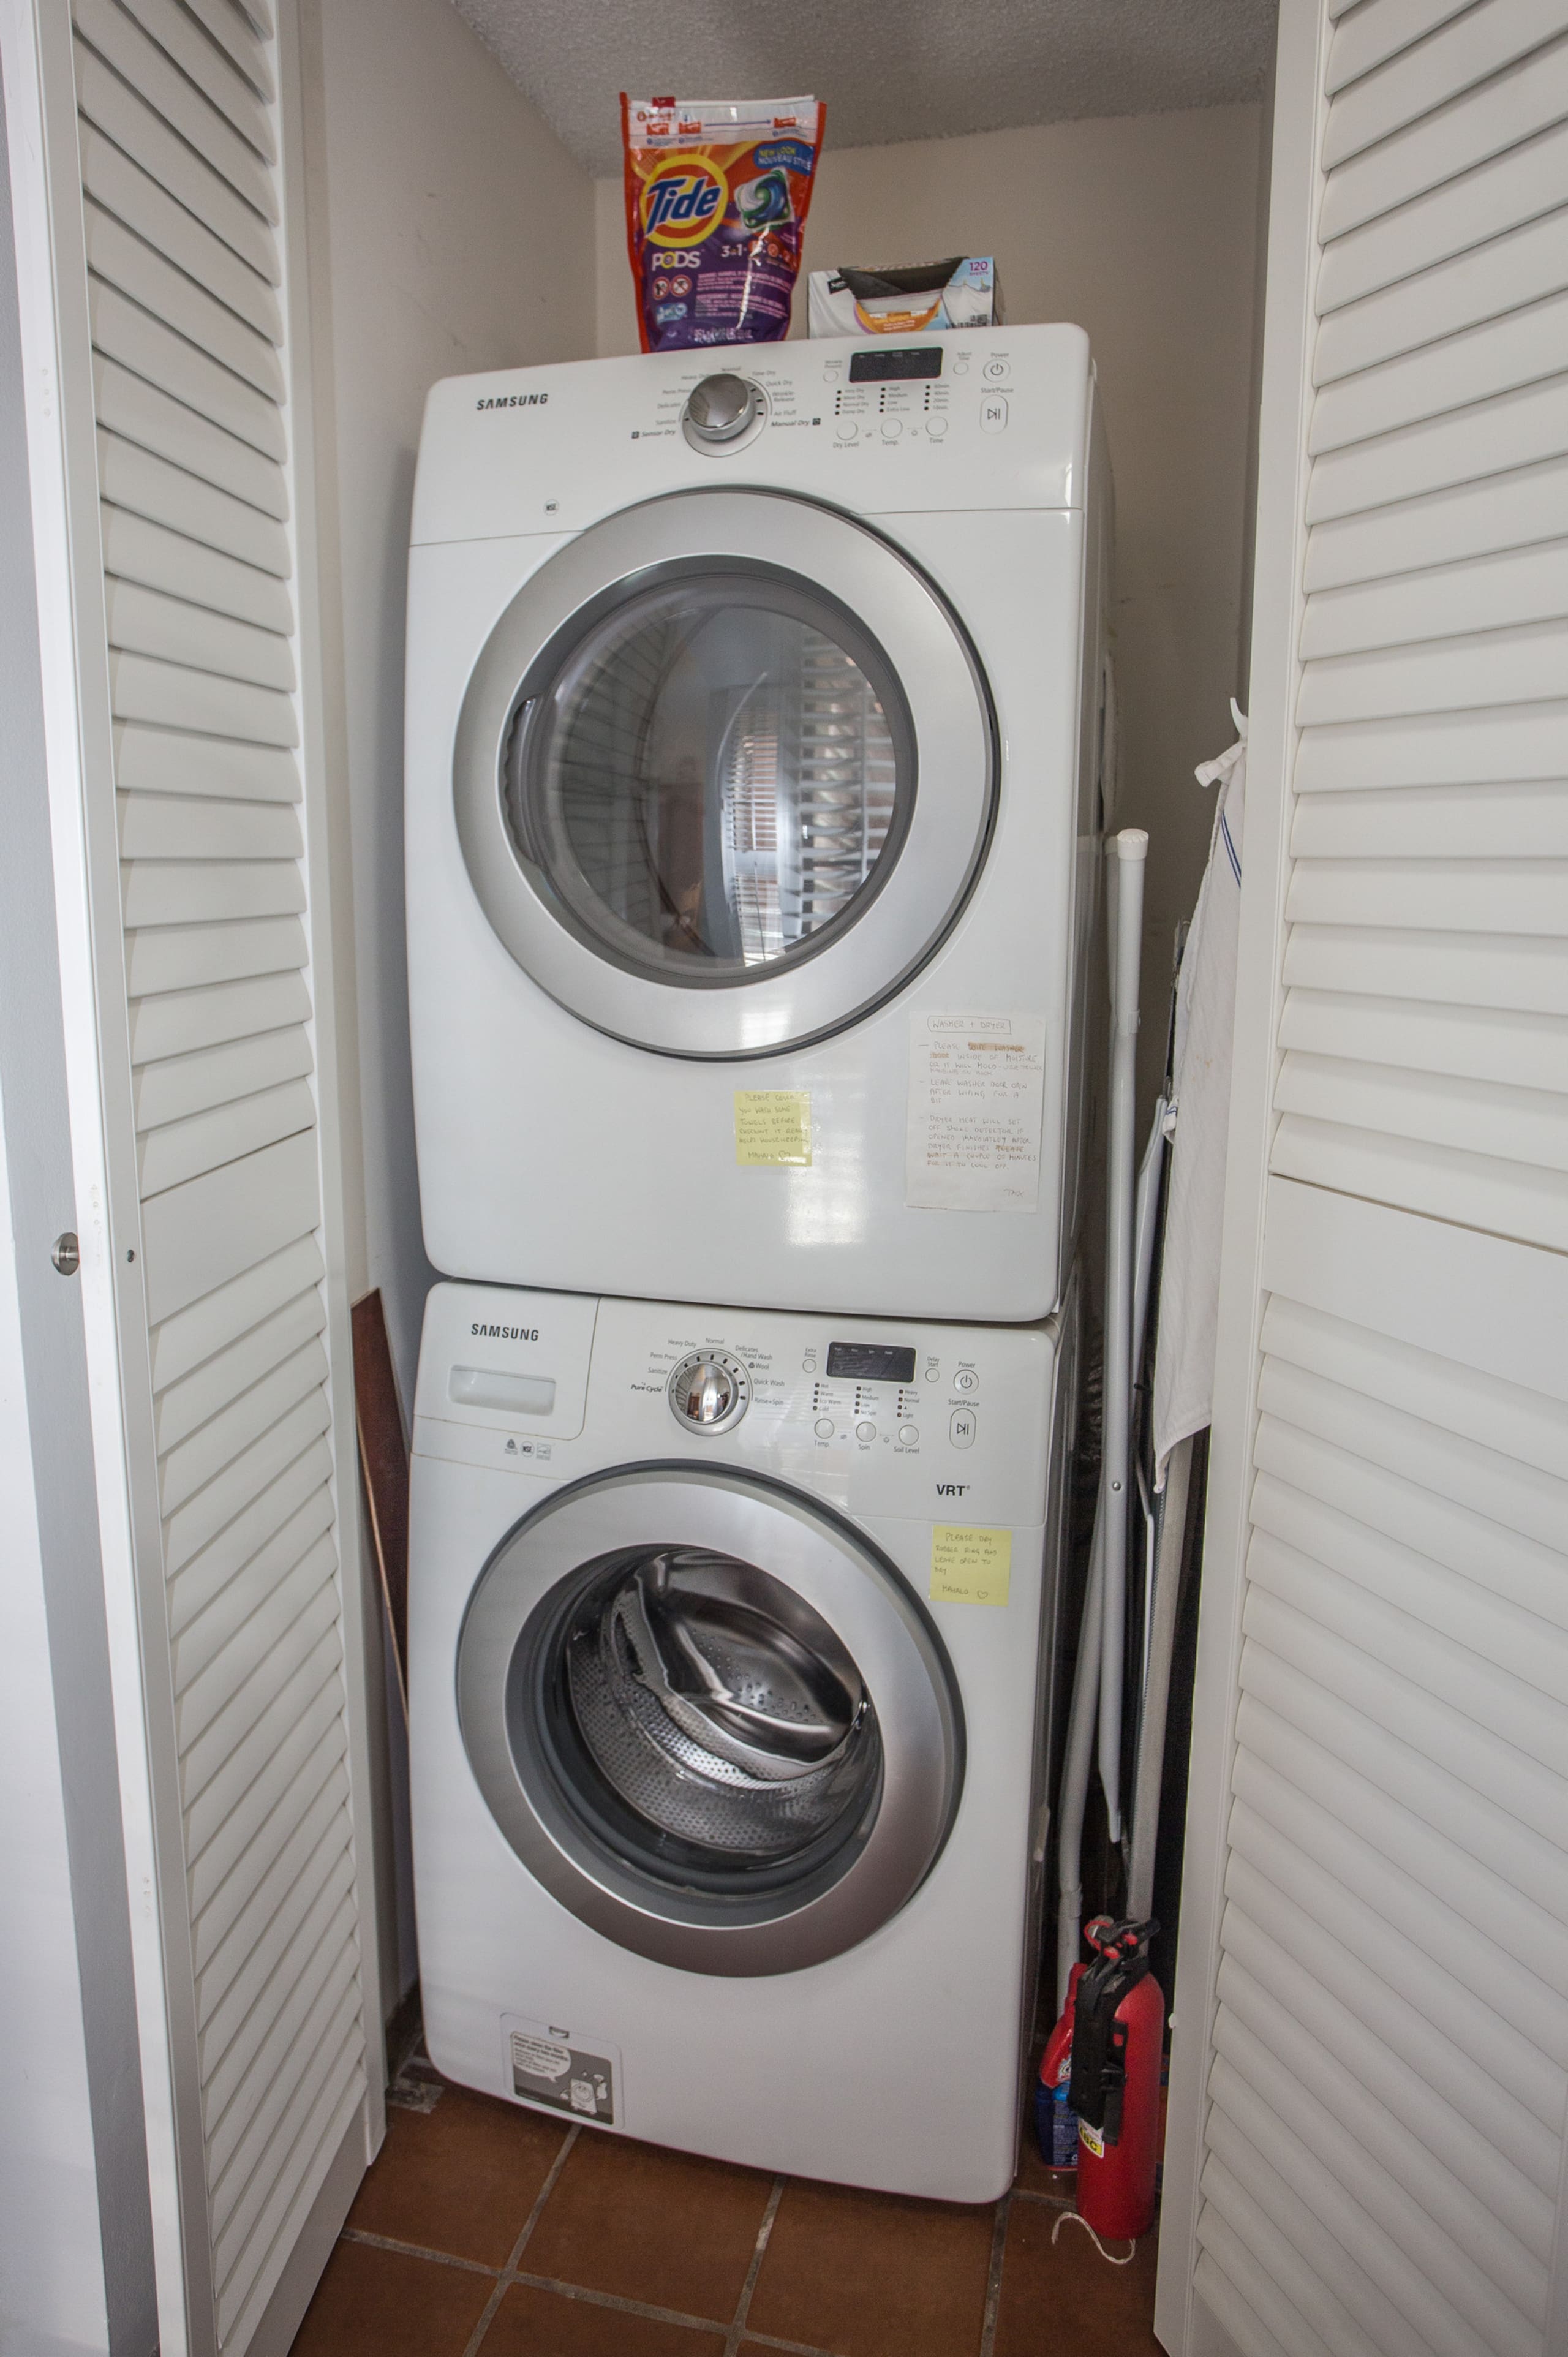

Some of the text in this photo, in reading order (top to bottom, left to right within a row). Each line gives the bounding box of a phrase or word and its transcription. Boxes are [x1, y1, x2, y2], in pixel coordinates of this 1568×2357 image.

[646, 176, 722, 238] Tide
[652, 251, 701, 271] PODS
[970, 261, 989, 271] 120
[477, 393, 549, 410] SAMSUNG
[932, 1020, 965, 1028] WASHER
[934, 1041, 960, 1050] PLEASE
[994, 1044, 1025, 1053] WASHER
[930, 1115, 952, 1123] DRYER
[471, 1323, 539, 1341] SAMSUNG
[648, 1367, 668, 1375] Sanitize
[945, 1532, 992, 1545] PLEASE DRY
[934, 1566, 947, 1575] DRY
[941, 1585, 969, 1594] MAHALO
